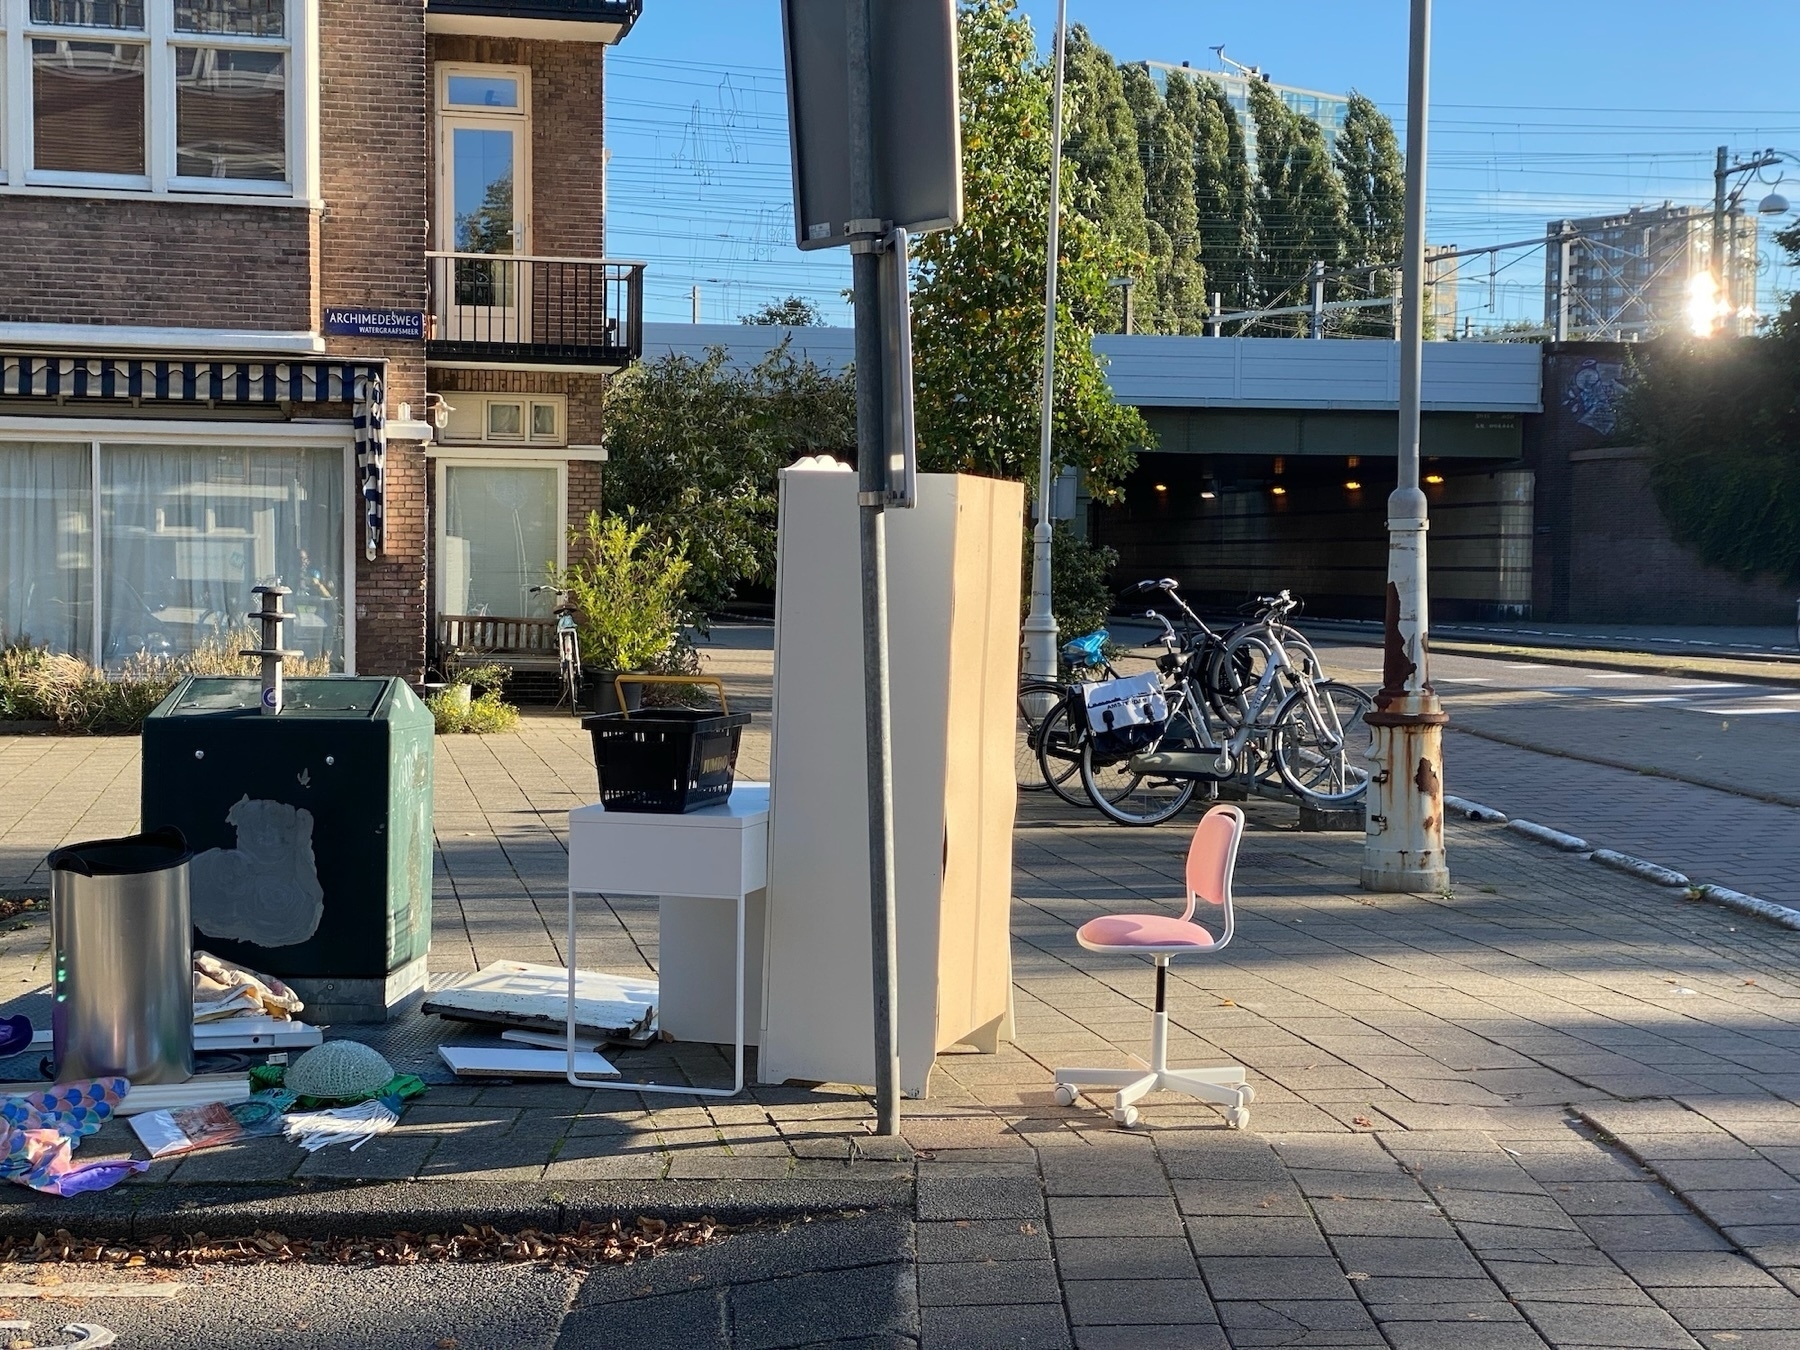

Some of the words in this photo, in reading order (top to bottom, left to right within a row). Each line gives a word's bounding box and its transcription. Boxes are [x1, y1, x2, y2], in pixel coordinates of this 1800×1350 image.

[329, 312, 419, 326] ARCHIMEDESWEG
[359, 326, 419, 335] WATERGRAAFSMEER
[1107, 697, 1148, 710] AMSTEDAM
[702, 755, 728, 774] JUMBO
